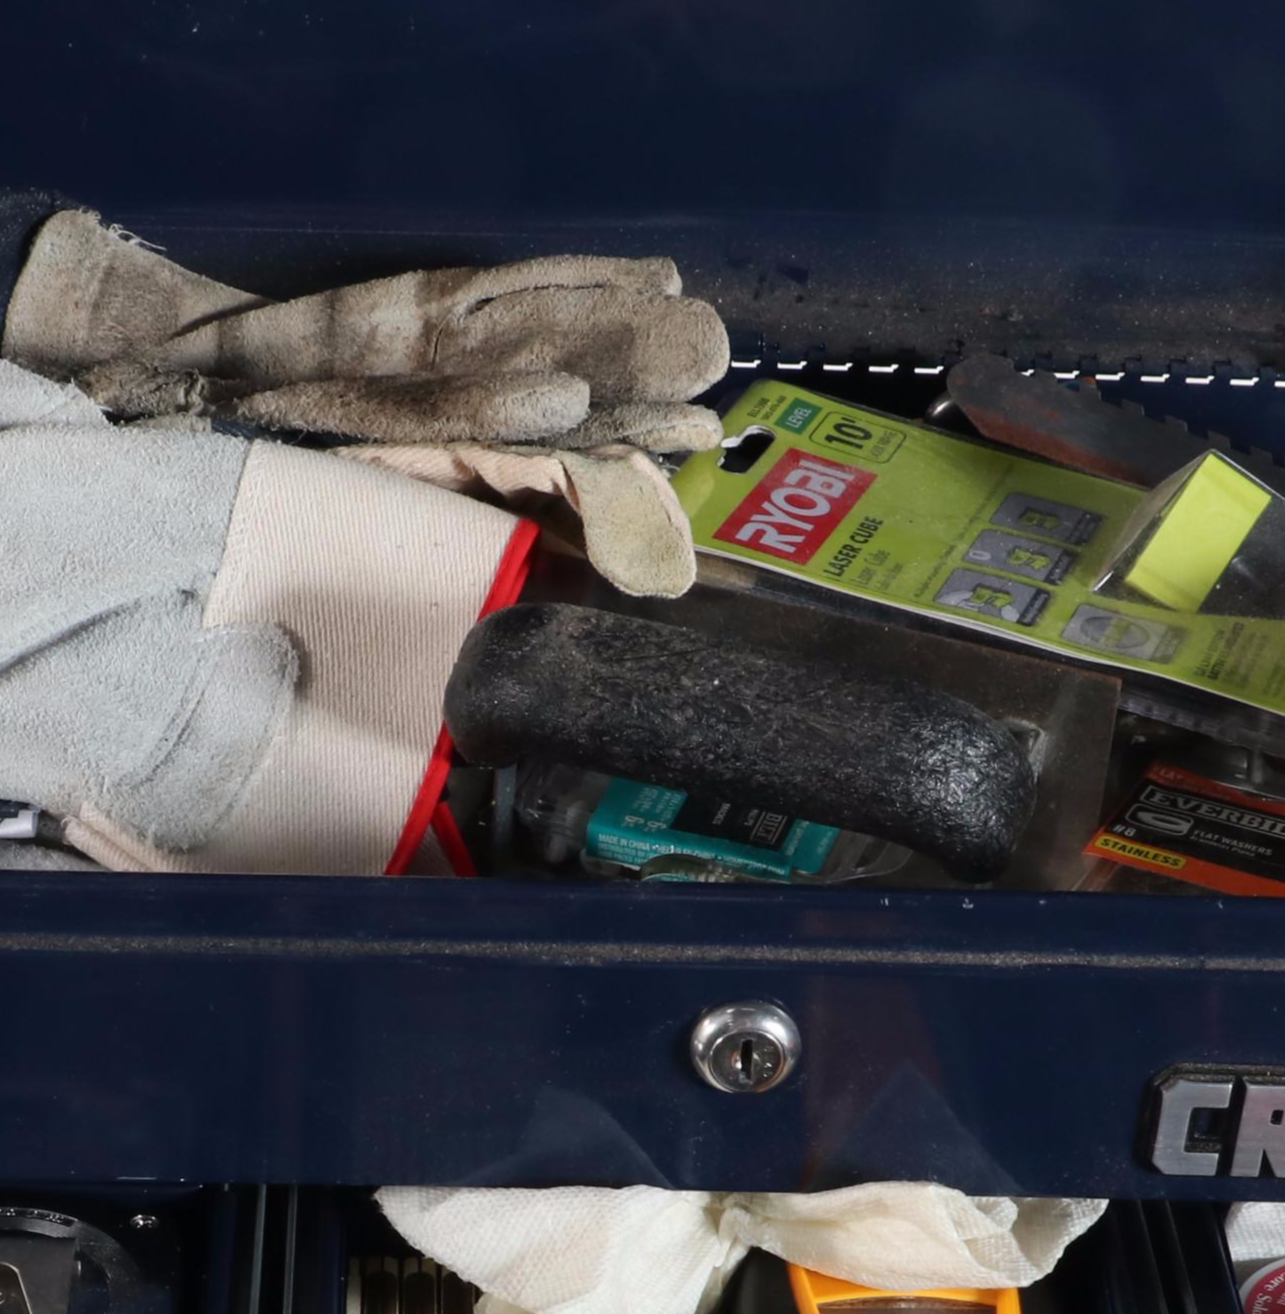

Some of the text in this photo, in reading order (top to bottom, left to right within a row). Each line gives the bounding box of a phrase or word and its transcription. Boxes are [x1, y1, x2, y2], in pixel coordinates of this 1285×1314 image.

[785, 407, 811, 429] LEVEL
[734, 460, 855, 553] RYOBI
[823, 516, 883, 577] LASER CUBE
[1113, 825, 1136, 837] #8
[1194, 829, 1273, 856] FLAT WASHERS
[1100, 838, 1182, 867] STAINLESS
